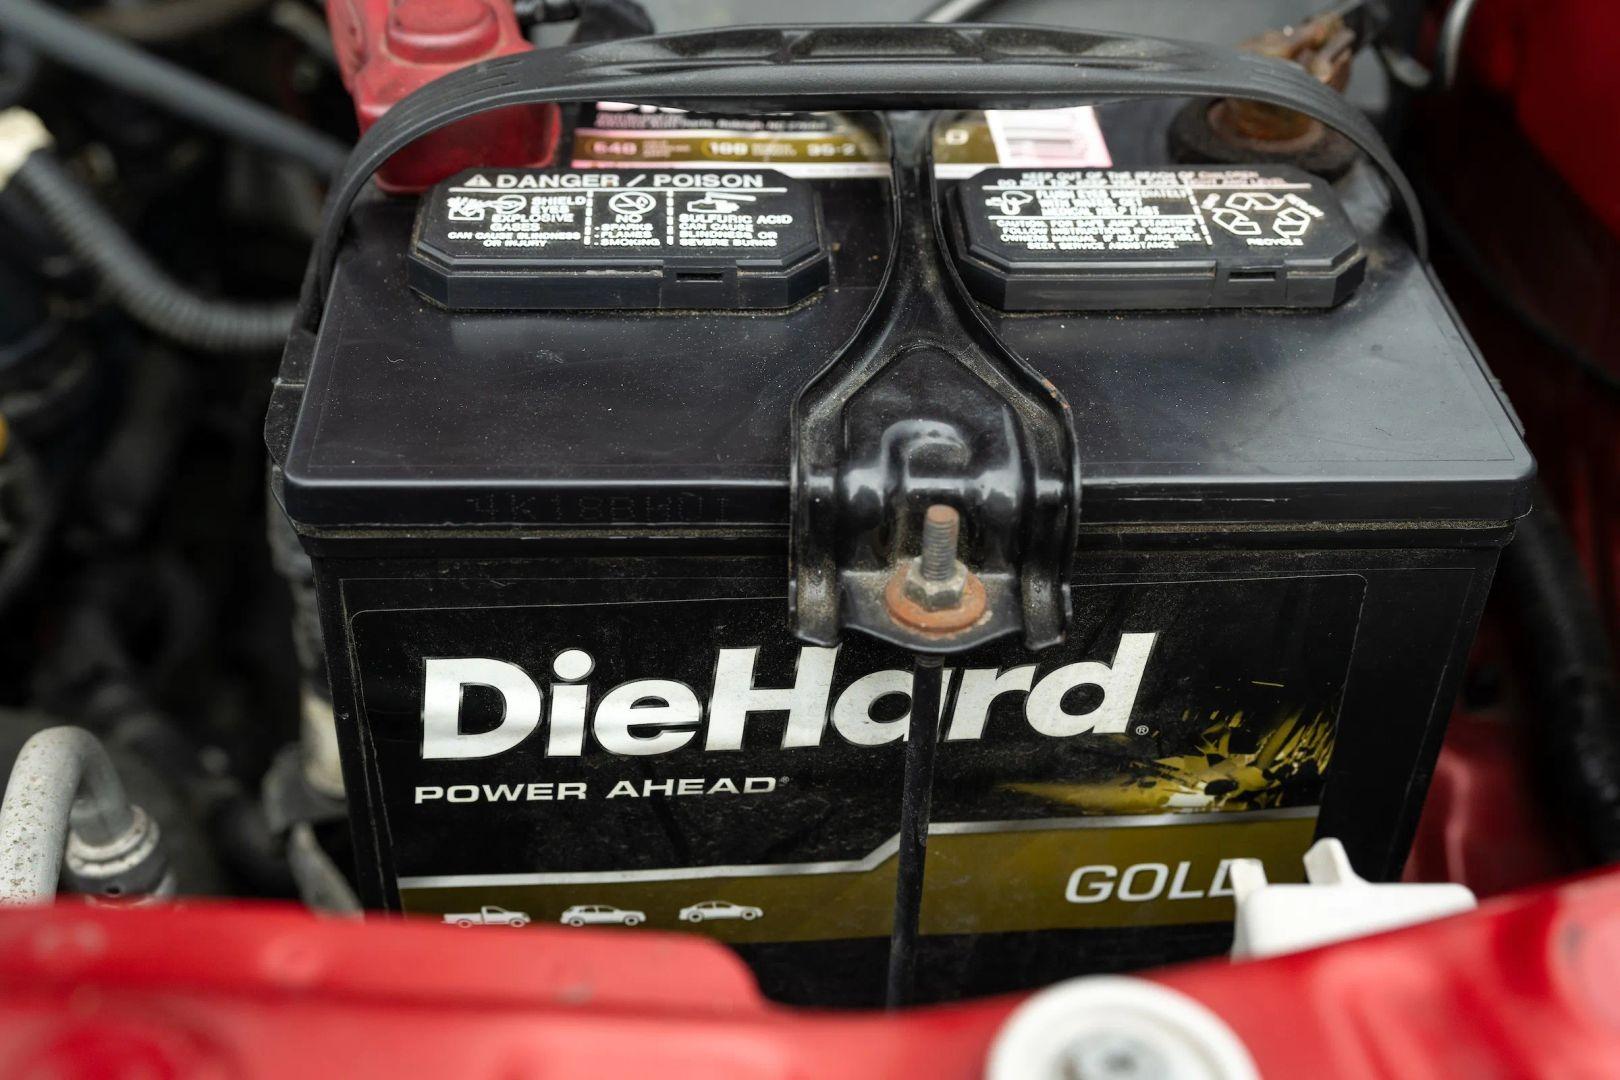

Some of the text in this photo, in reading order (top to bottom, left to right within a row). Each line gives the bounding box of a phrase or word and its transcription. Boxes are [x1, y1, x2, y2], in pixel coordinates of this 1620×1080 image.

[496, 174, 764, 188] DANGER / POISON
[531, 196, 587, 206] SHIELD
[491, 213, 575, 223] EXPLOSIVE
[615, 213, 643, 223] NO
[679, 213, 793, 224] SULFURIC ACID
[490, 222, 541, 231] GASES
[600, 223, 653, 231] SPARKS
[679, 222, 754, 232] CAN CAUSE
[447, 232, 581, 240] CAN CAUSE BLINDNESS
[600, 231, 653, 239] FLAMES
[679, 231, 778, 240] BLINDNESS OR
[483, 239, 548, 247] OR INJURY
[600, 238, 661, 246] SMOKING
[679, 238, 778, 247] SEVERE BURNS
[1058, 241, 1105, 250] SERVICE
[1246, 238, 1304, 246] RECYCLE
[421, 631, 1158, 761] DieHard
[414, 776, 778, 804] POWER AHEAD
